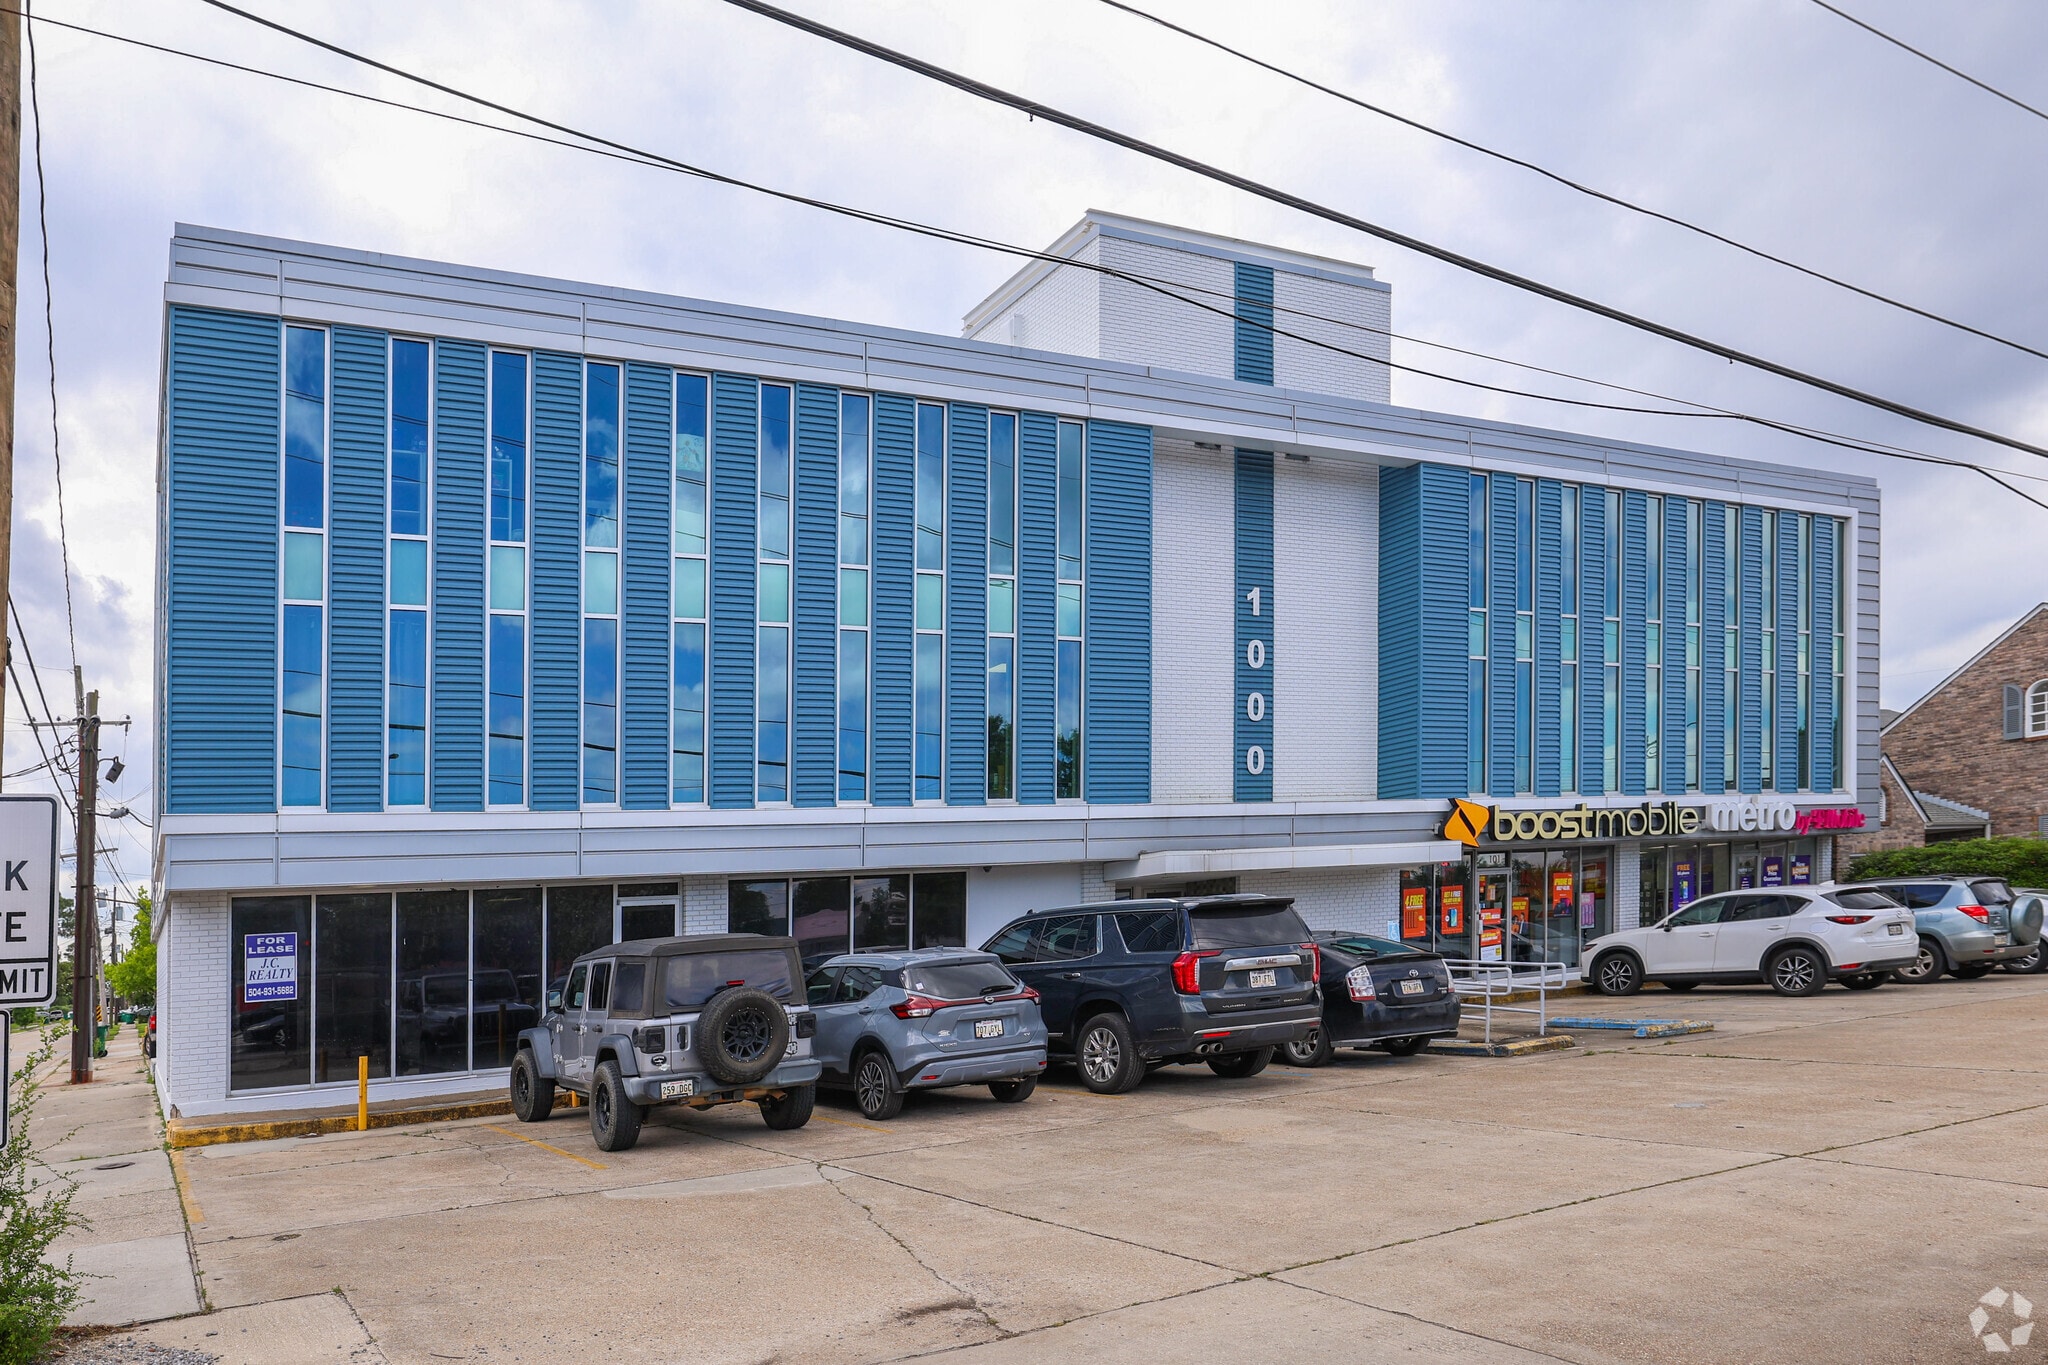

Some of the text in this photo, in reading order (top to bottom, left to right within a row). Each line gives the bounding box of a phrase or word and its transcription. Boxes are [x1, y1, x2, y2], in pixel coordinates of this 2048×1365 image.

[1247, 587, 1265, 774] 1000
[1707, 802, 1796, 831] metro
[1796, 810, 1811, 835] by
[1489, 855, 1500, 864] 101
[1405, 894, 1424, 906] 4 FREE
[0, 911, 27, 942] E
[257, 936, 286, 945] FOR
[248, 945, 294, 954] LEASE
[261, 958, 280, 969] J.C.
[249, 968, 293, 980] REALTY
[663, 1086, 675, 1095] 259
[680, 1083, 692, 1093] DGC
